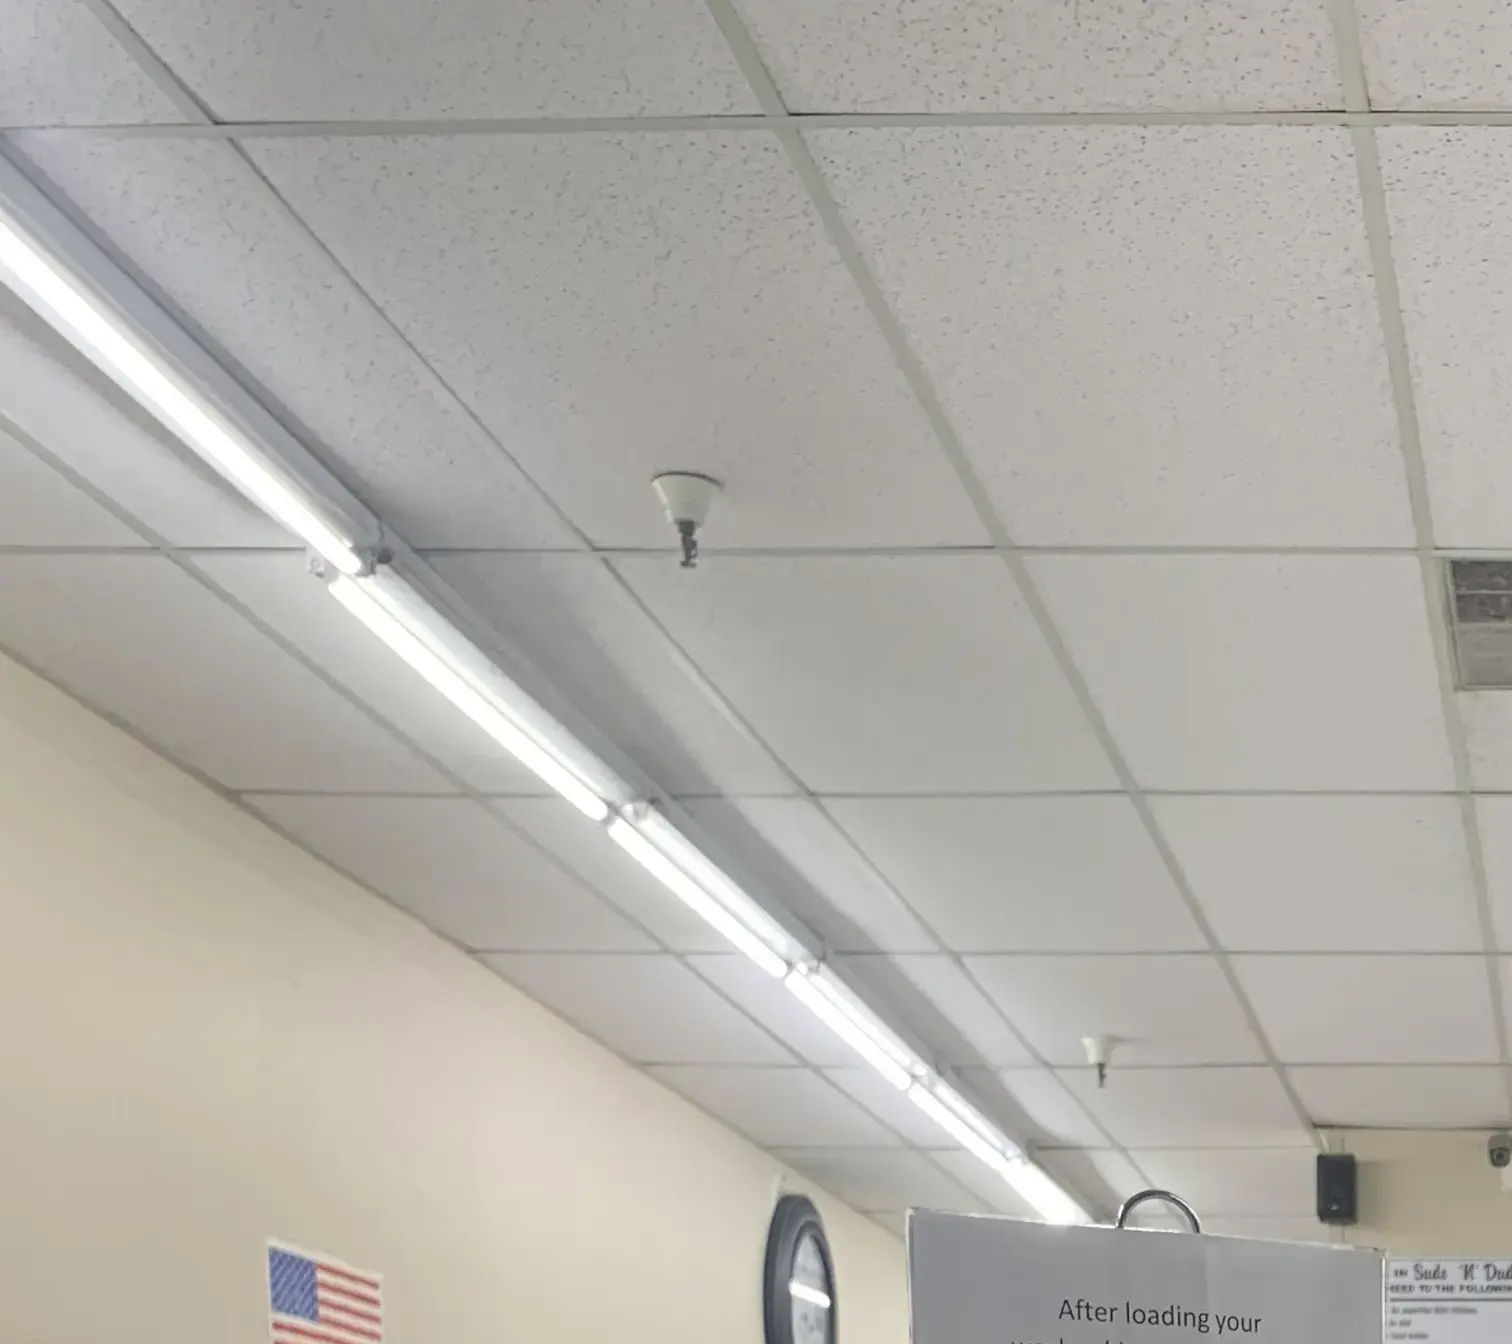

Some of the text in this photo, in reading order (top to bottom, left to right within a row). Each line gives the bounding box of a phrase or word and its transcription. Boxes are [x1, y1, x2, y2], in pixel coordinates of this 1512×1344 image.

[1435, 1284, 1456, 1293] THE
[1058, 1299, 1263, 1336] After loading your
